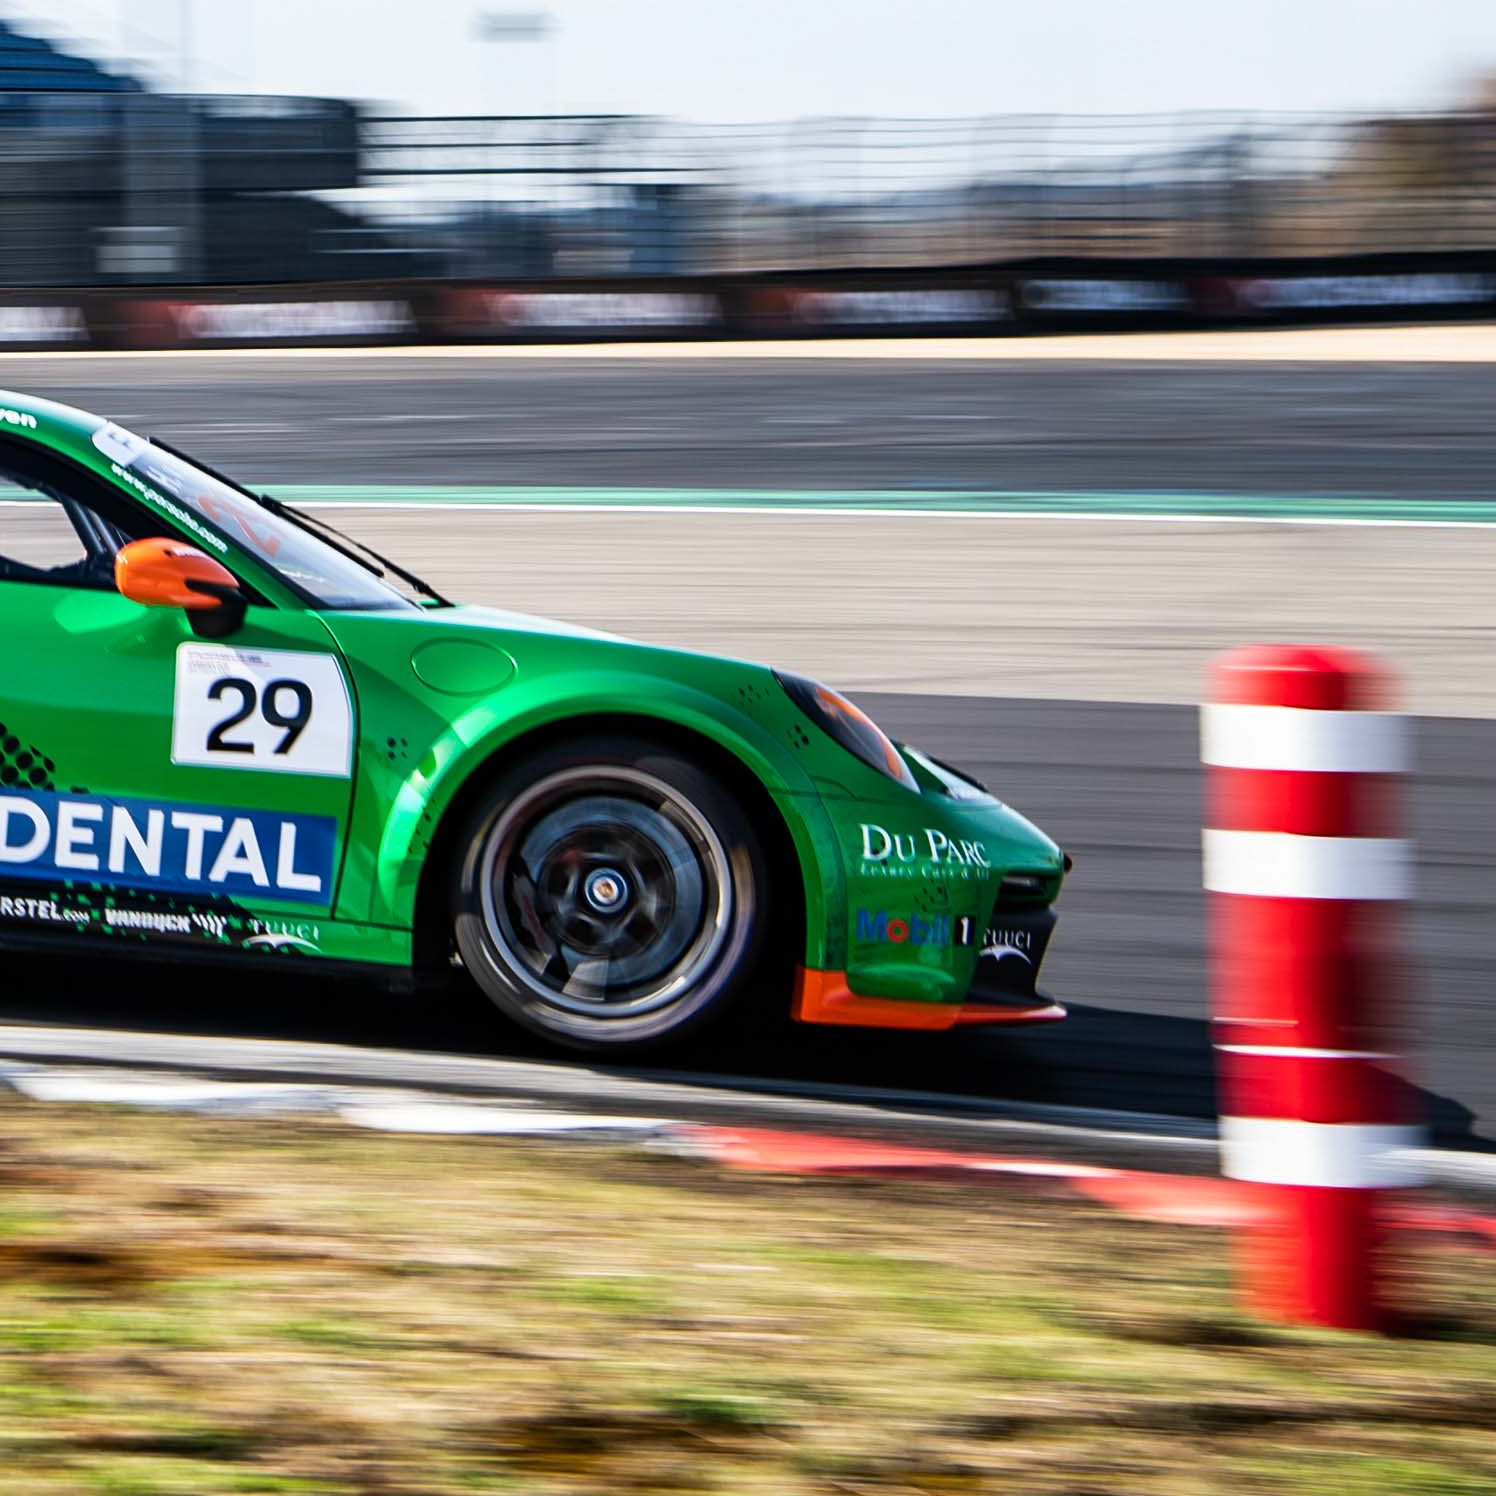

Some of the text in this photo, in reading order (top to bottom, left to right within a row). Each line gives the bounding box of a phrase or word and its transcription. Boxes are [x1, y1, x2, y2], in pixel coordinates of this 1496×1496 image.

[206, 677, 313, 755] 29
[857, 908, 971, 946] Mobil 1
